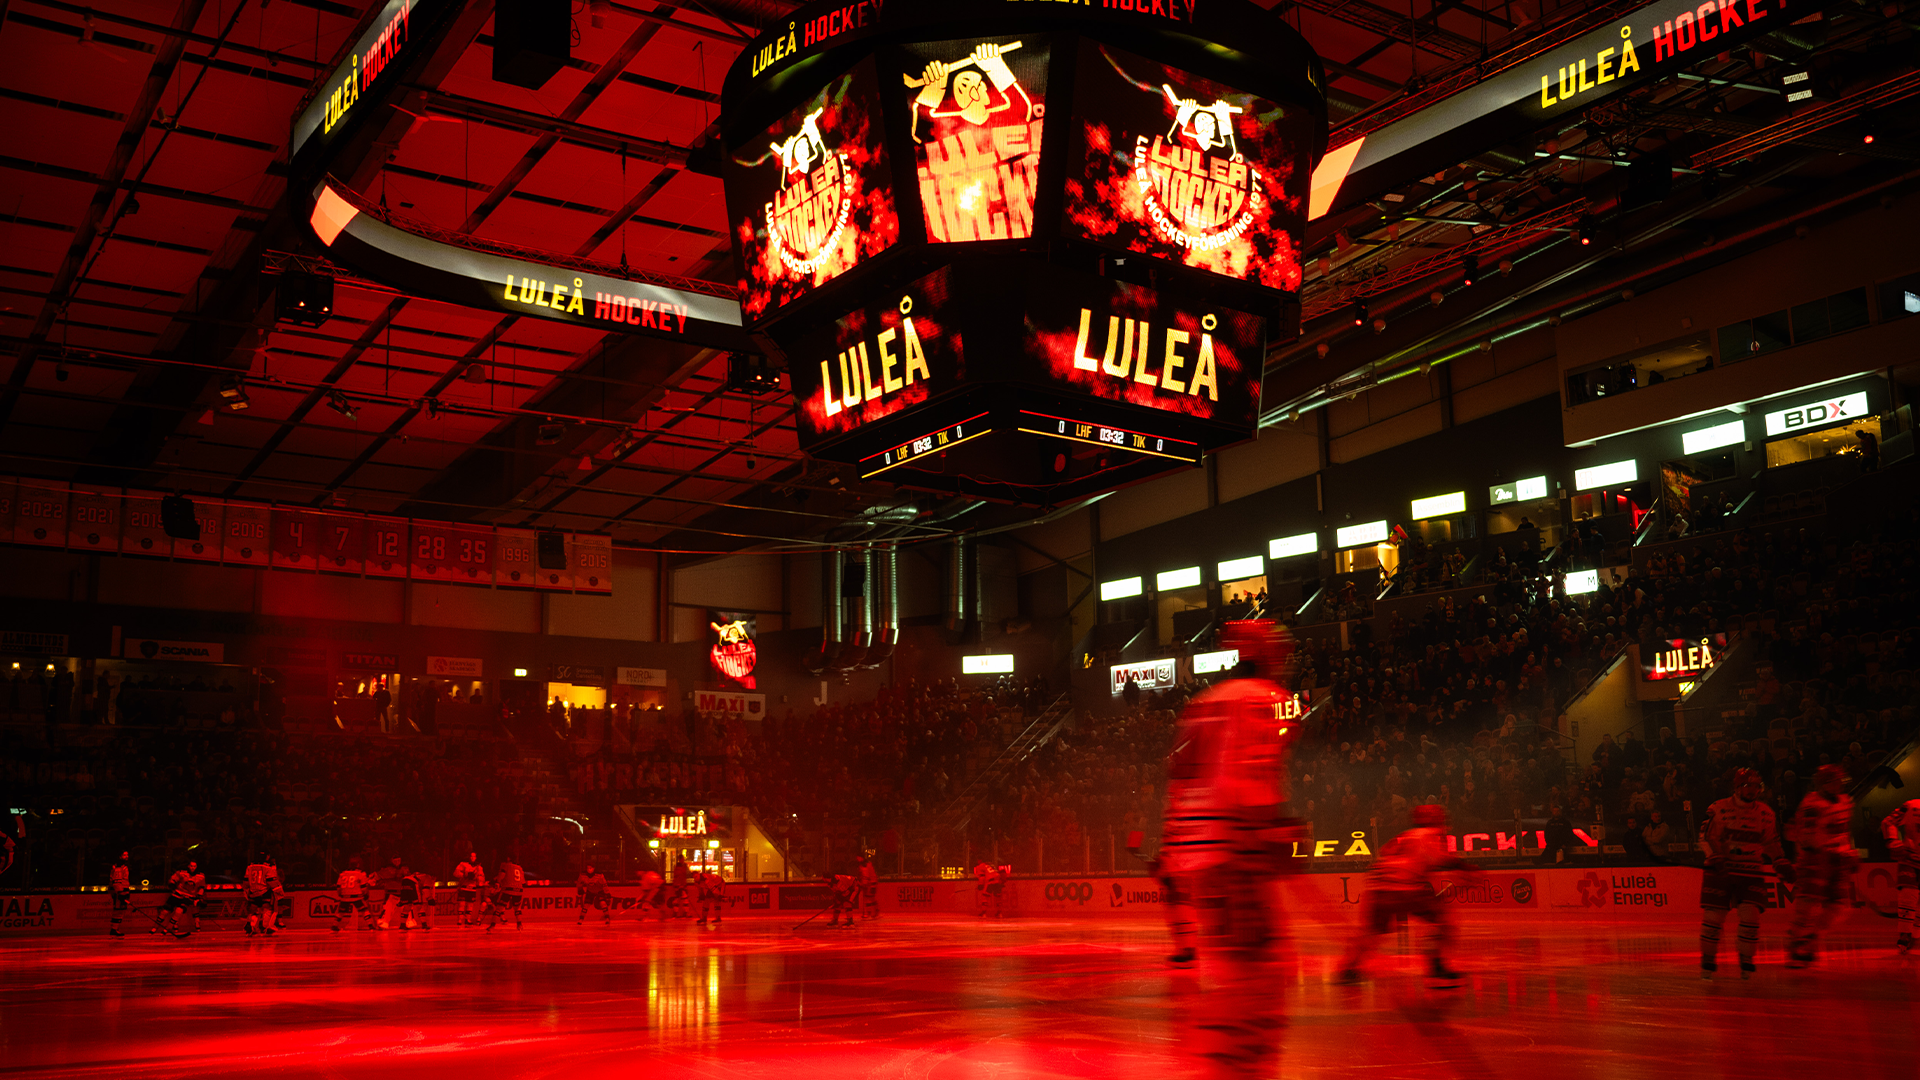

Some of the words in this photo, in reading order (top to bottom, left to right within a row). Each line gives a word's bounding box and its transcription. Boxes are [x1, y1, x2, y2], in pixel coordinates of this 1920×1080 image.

[753, 21, 796, 78] LULEÅ
[804, 0, 884, 47] HOCKEY
[324, 54, 359, 134] LULEÅ
[362, 0, 410, 92] HOCKEY
[1541, 25, 1641, 109] LULEÅ
[1653, 0, 1787, 63] HOCKE
[1151, 134, 1248, 190] LULEÅ
[774, 149, 841, 218] LULEÅ
[1134, 135, 1153, 195] LULEÅ
[1145, 195, 1254, 251] HOCKEYFÖRENING
[1250, 168, 1262, 210] 1977
[1150, 160, 1246, 230] HOCKEY
[776, 182, 841, 254] HOCKEY
[504, 274, 585, 316] LULEÅ
[594, 291, 688, 334] HOCKEY
[820, 295, 930, 417] LULEÅ
[1073, 308, 1219, 401] LULEÅ
[1784, 399, 1848, 429] BDX
[885, 452, 891, 465] 0
[896, 445, 909, 461] LHF
[937, 430, 950, 445] TIK
[956, 425, 963, 438] 0
[1058, 420, 1065, 434] 0
[1075, 424, 1093, 438] LHF
[1099, 428, 1124, 444] 03:32
[1132, 434, 1146, 448] TIK
[1156, 439, 1163, 451] 0
[21, 500, 63, 519] 2022
[77, 506, 114, 525] 2021
[231, 521, 265, 539] 2016
[290, 521, 304, 548] 4
[335, 526, 350, 551] 7
[376, 530, 399, 557] 12
[418, 534, 447, 561] 28
[459, 538, 486, 564] 35
[161, 646, 209, 657] SCANIA
[346, 654, 396, 665] TITAN
[1655, 638, 1714, 673] LULEÅ
[1116, 668, 1155, 684] MAXI
[700, 694, 745, 712] MAXI
[660, 810, 707, 834] LULEÅ
[1291, 831, 1371, 858] LEÅ
[514, 869, 521, 882] 9
[1612, 872, 1657, 889] Luleå
[751, 893, 768, 904] CAT
[897, 886, 934, 902] SPORT
[1045, 882, 1093, 905] coop
[1126, 891, 1163, 904] LINDB
[1441, 878, 1504, 905] Dumle
[1613, 891, 1668, 907] Energi
